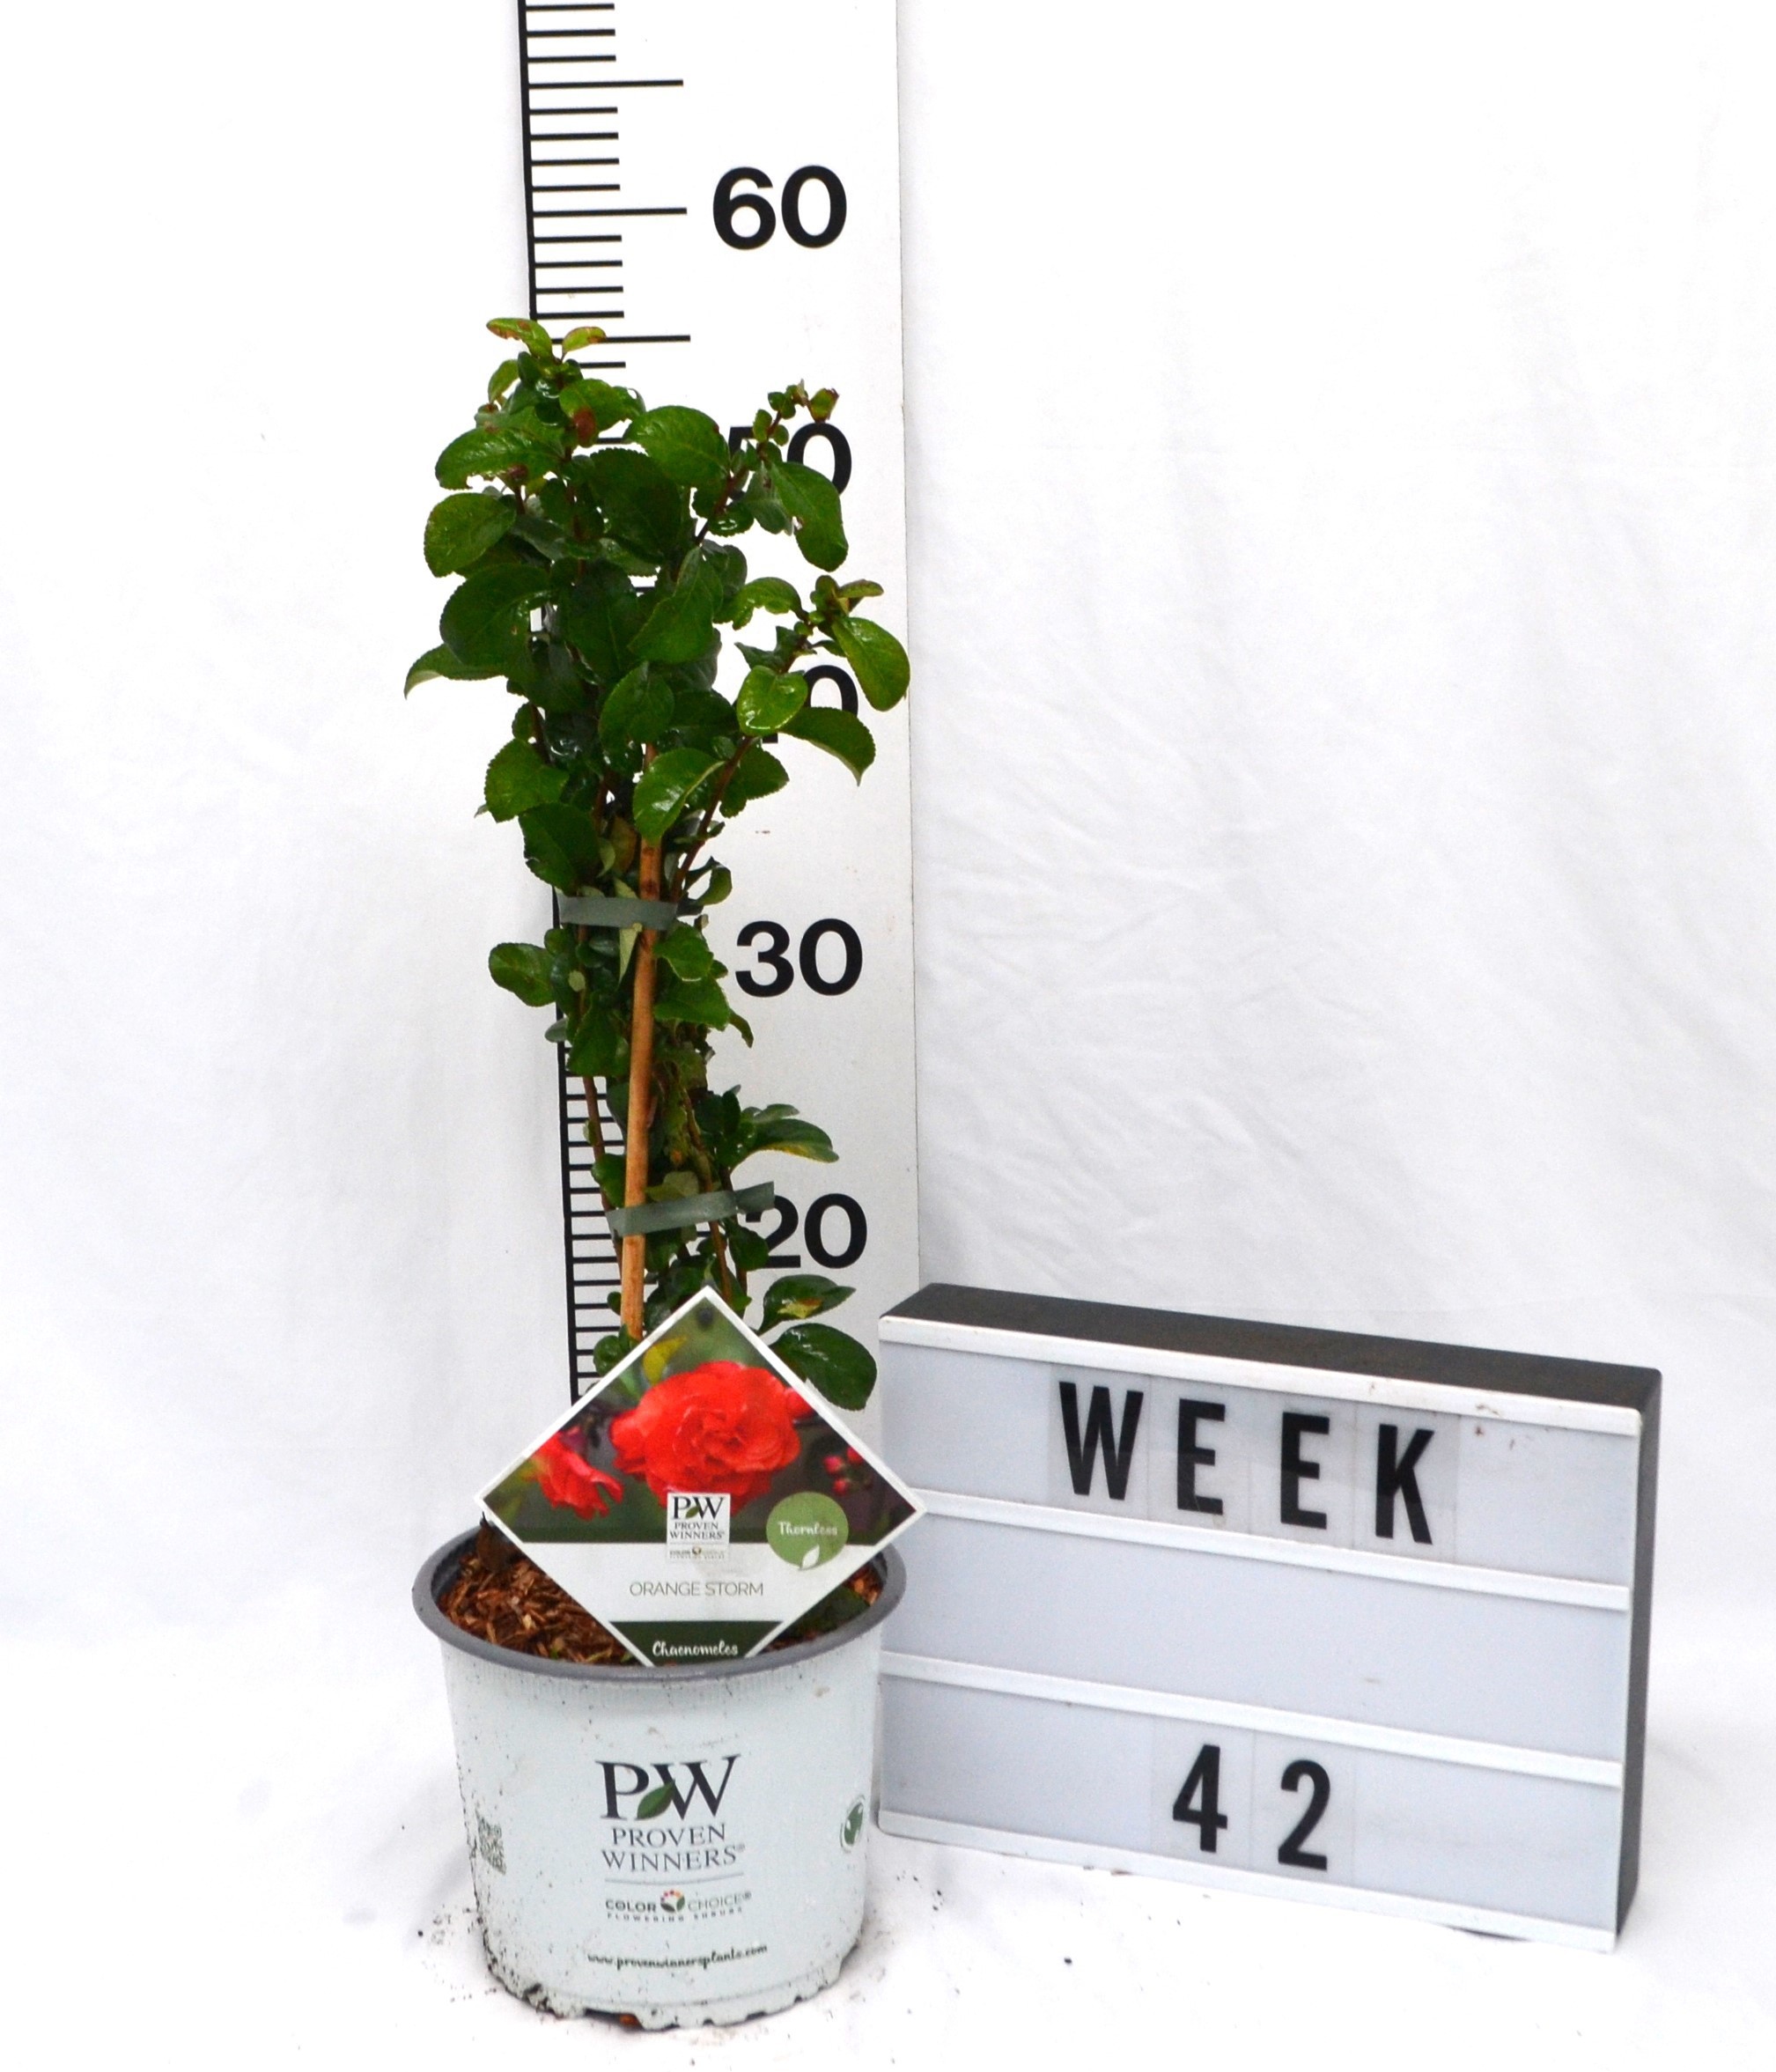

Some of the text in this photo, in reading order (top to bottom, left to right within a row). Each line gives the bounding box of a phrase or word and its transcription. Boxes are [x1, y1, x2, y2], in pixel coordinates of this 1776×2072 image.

[712, 165, 847, 250] 60
[735, 918, 863, 998] 30
[745, 1193, 867, 1269] 20
[1058, 1382, 1434, 1545] WEEK
[671, 1496, 726, 1520] PW
[674, 1522, 719, 1530] PROVEN
[777, 1521, 838, 1536] Thornless
[629, 1582, 764, 1596] ORANGE STORM
[652, 1639, 739, 1657] Chaenomeles
[594, 1753, 741, 1820] PW
[1172, 1745, 1332, 1871] 42
[612, 1823, 726, 1848] PROVEN
[605, 1898, 657, 1913] COLOR
